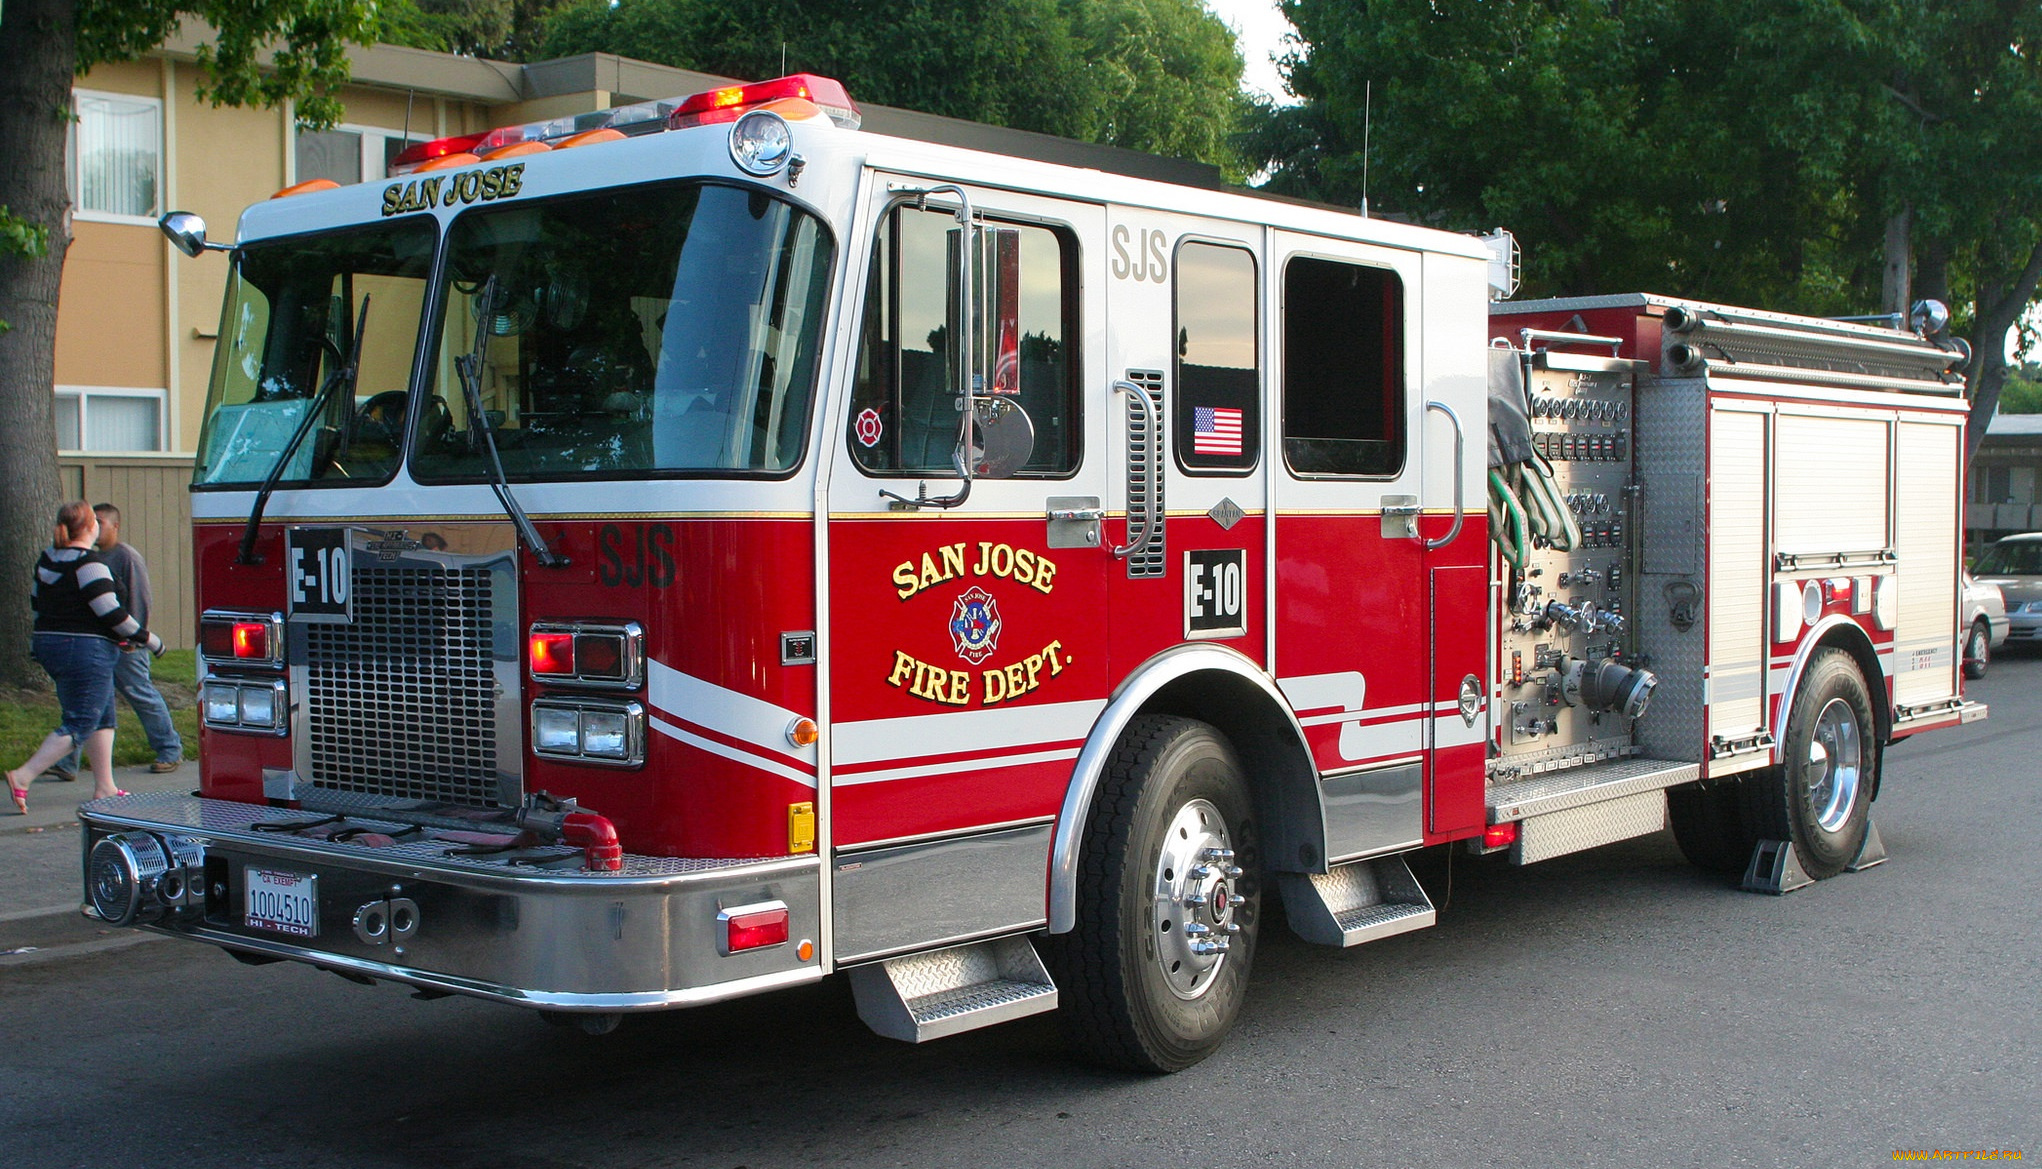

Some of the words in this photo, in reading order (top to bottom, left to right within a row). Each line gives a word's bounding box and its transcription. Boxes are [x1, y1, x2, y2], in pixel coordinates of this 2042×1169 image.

[382, 175, 446, 216] SAN
[443, 163, 525, 206] JOSE
[1112, 224, 1167, 284] SJS
[291, 546, 347, 605] E-10
[600, 523, 676, 588] SJS
[892, 542, 966, 601] SAN
[972, 541, 1056, 595] JOSE
[1190, 562, 1241, 618] E-10
[885, 649, 971, 706] FIRE
[981, 639, 1073, 706] DEPT.
[251, 889, 310, 925] 1004510
